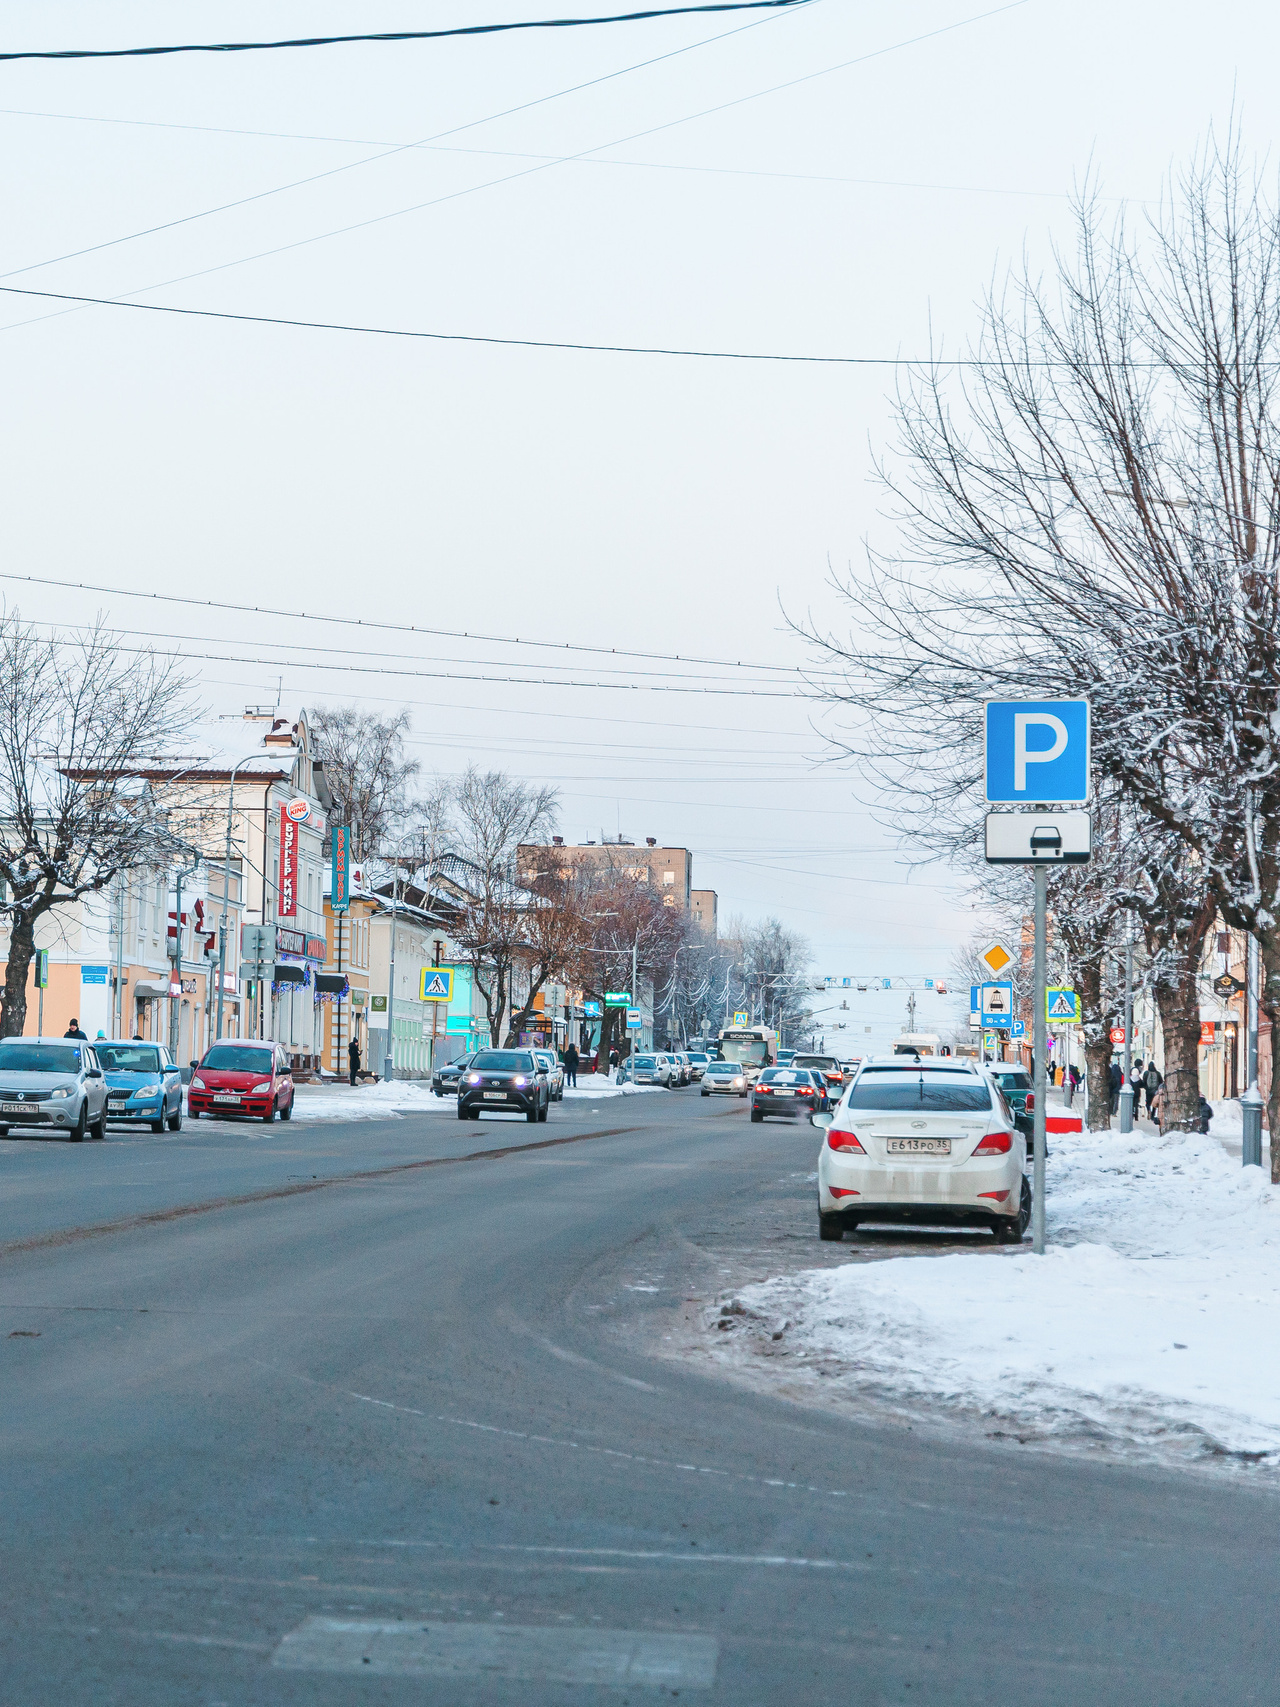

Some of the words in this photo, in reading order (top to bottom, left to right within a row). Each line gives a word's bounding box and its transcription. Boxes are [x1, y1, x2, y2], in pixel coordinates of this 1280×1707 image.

[1014, 713, 1069, 791] P
[290, 806, 307, 815] KING
[284, 822, 294, 876] БУРГЕР
[336, 829, 345, 872] КОРМИМ
[283, 878, 293, 914] КИНГ
[1013, 1022, 1023, 1034] P
[891, 1140, 934, 1151] Е613РО
[936, 1140, 947, 1149] 35
